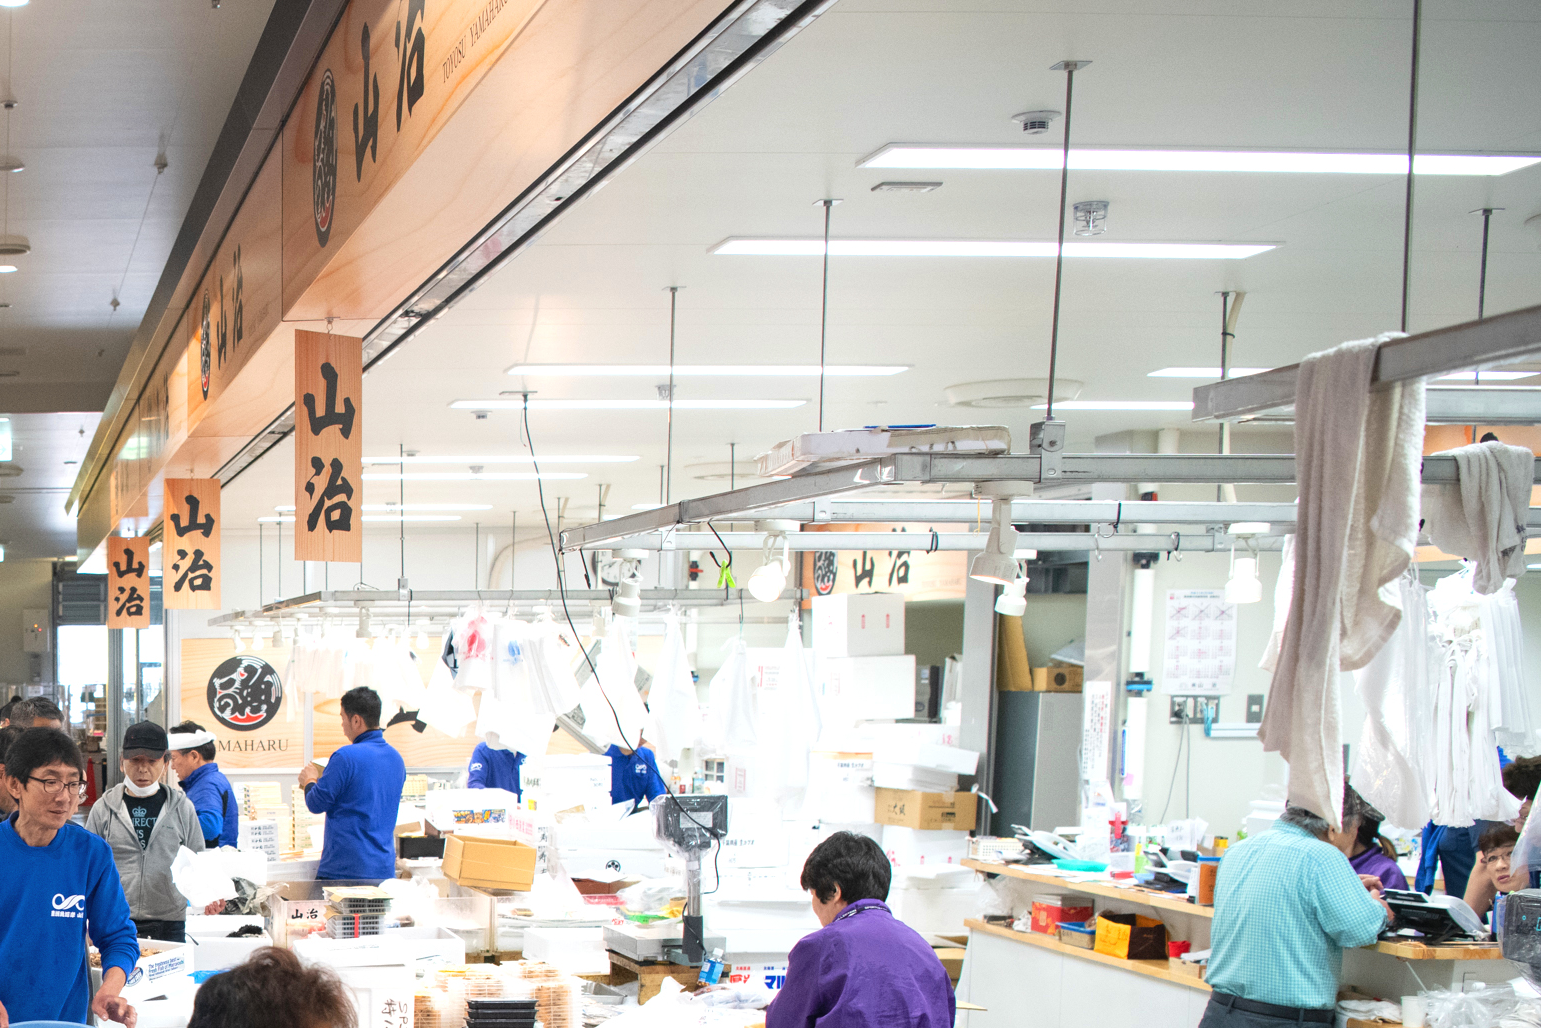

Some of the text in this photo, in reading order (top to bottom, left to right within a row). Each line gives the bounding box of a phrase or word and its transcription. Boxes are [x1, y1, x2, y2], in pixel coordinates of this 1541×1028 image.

[469, 0, 508, 47] YAMAHA
[353, 0, 426, 182] 山治
[216, 243, 244, 371] 山治
[303, 362, 356, 534] 山治
[112, 548, 146, 618] 山治
[170, 495, 215, 592] 山治
[291, 908, 319, 920] 山治
